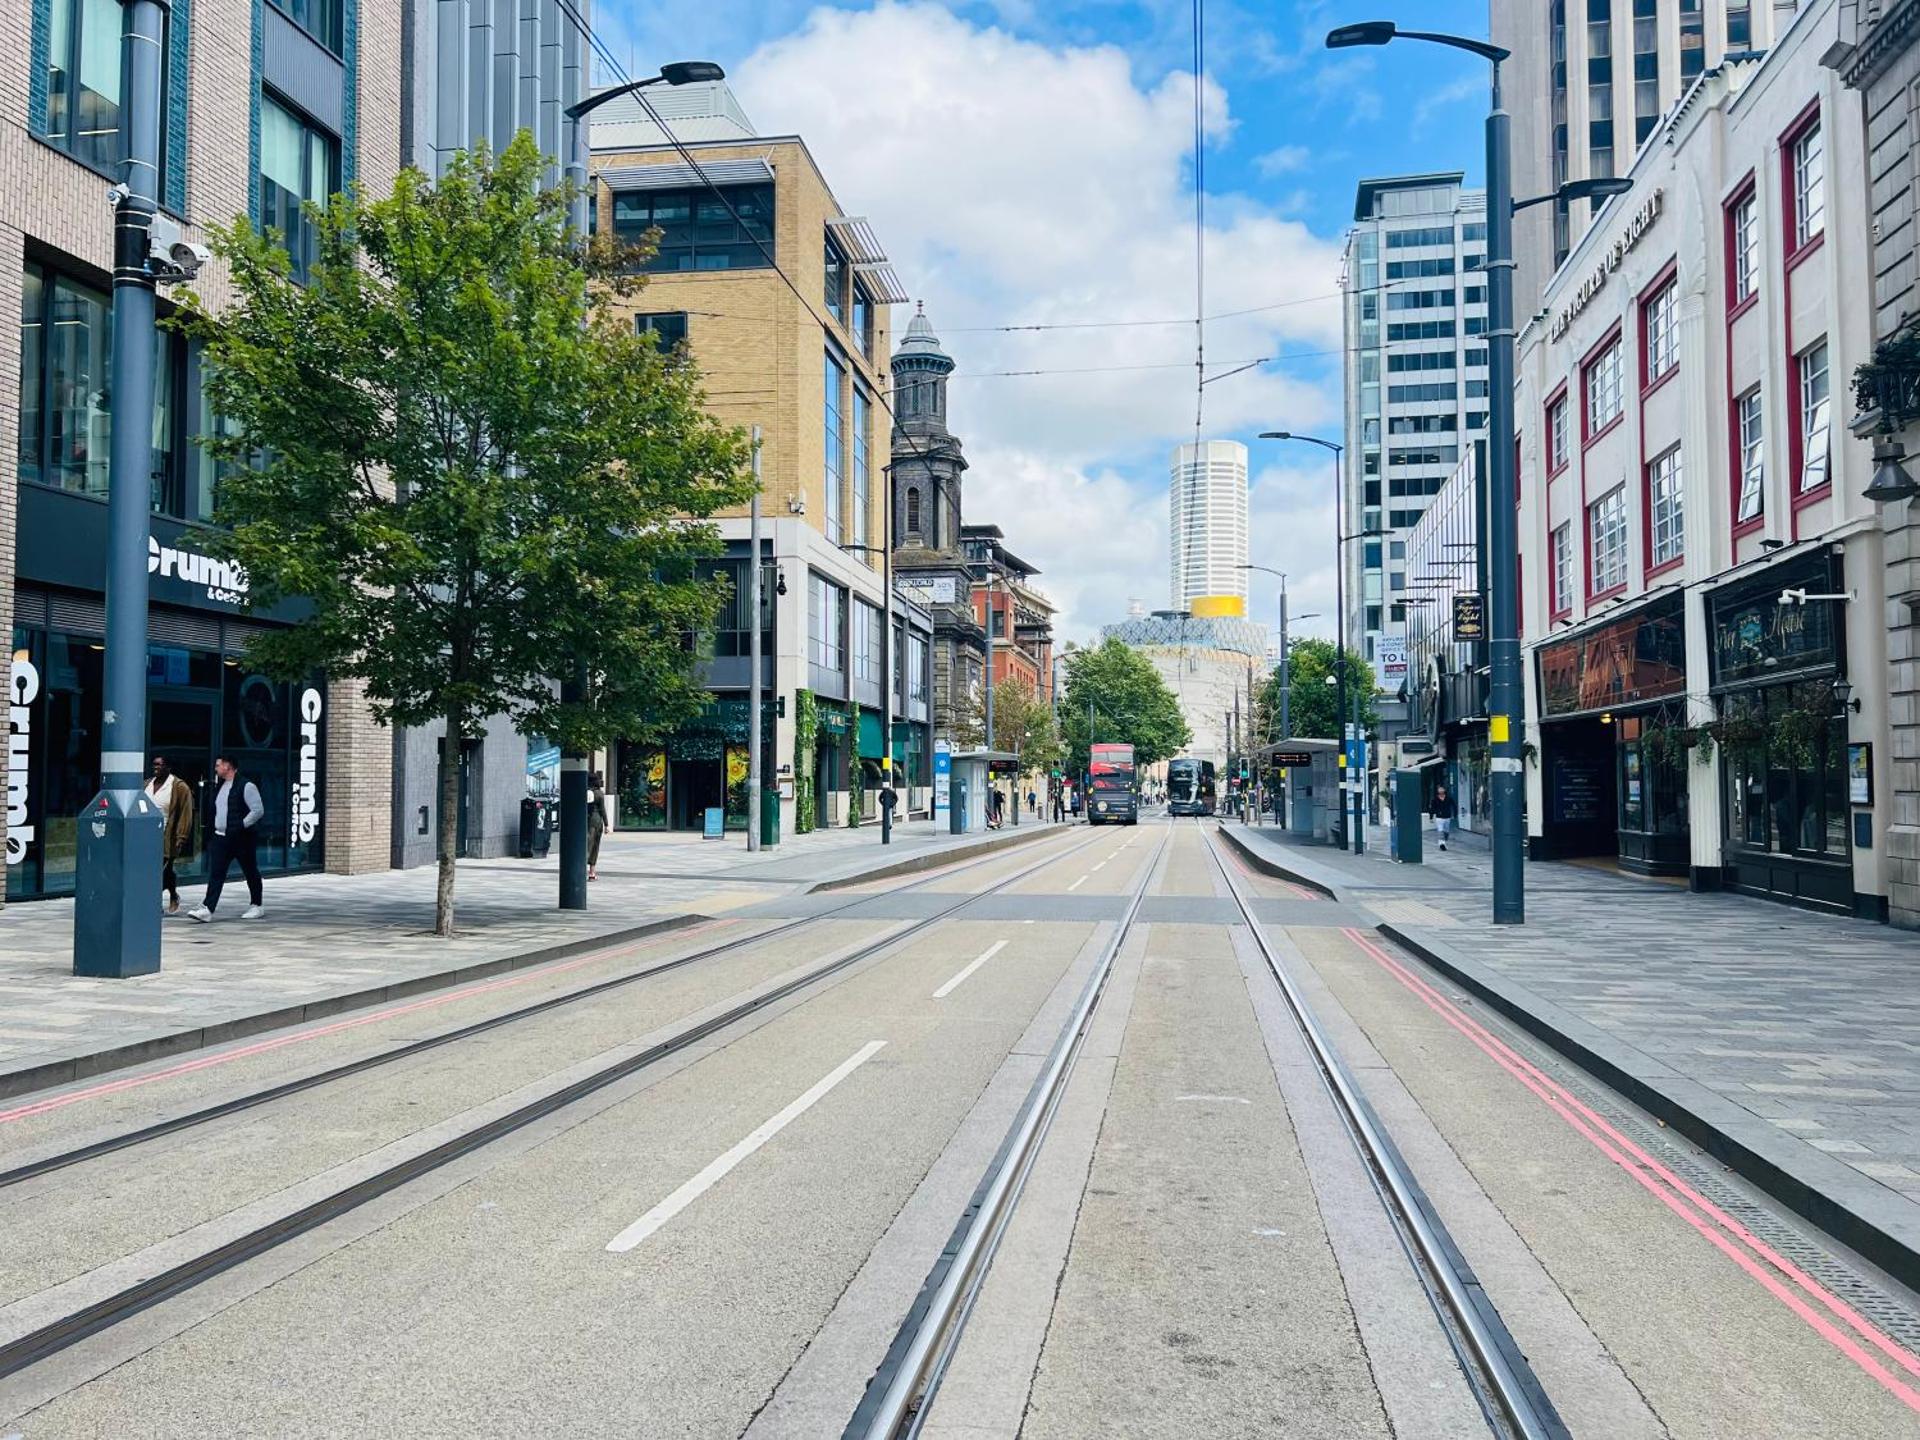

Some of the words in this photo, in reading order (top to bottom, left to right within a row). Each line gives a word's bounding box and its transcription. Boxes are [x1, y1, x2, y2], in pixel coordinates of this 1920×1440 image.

[1381, 653, 1398, 663] TO
[7, 661, 39, 865] Crumb
[299, 688, 322, 843] Crumb
